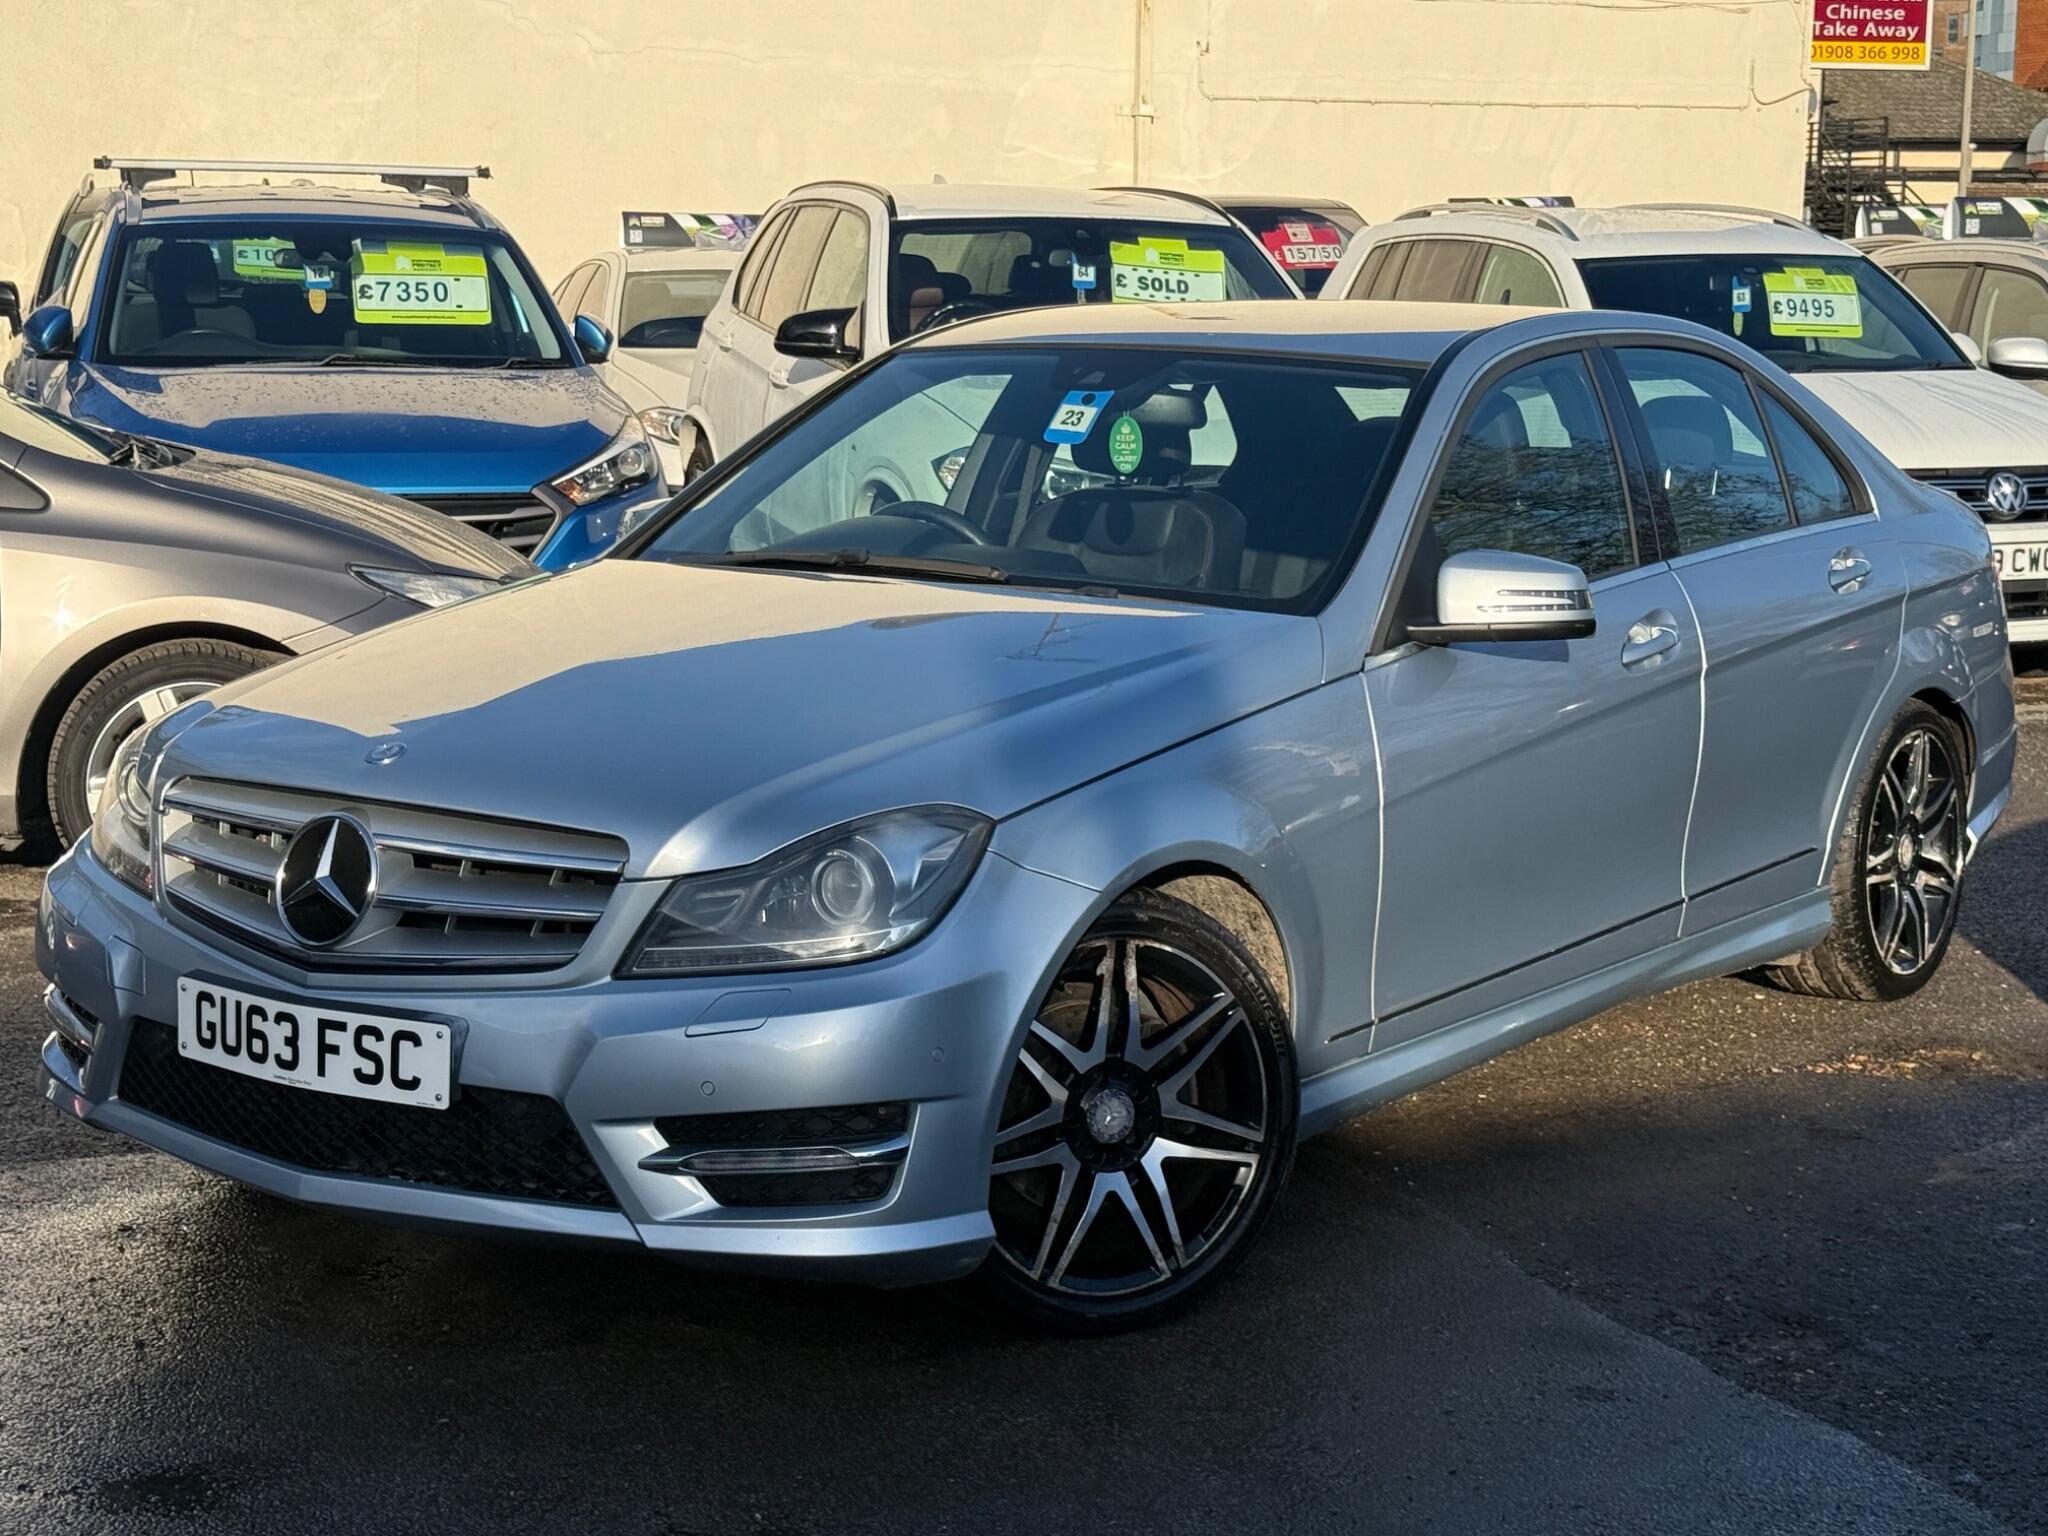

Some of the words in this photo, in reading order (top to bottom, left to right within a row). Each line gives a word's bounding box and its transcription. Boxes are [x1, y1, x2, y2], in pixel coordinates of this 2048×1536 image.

[1826, 4, 1906, 20] Chinese
[1813, 21, 1858, 37] Take
[1863, 21, 1919, 41] Away
[1858, 46, 1887, 59] 366
[1891, 46, 1920, 60] 998
[358, 280, 449, 303] £7350
[1137, 275, 1190, 295] SOLD
[1773, 298, 1835, 318] £9495
[1060, 410, 1085, 427] 23
[195, 990, 300, 1072] GU63
[317, 1017, 423, 1092] FSC
